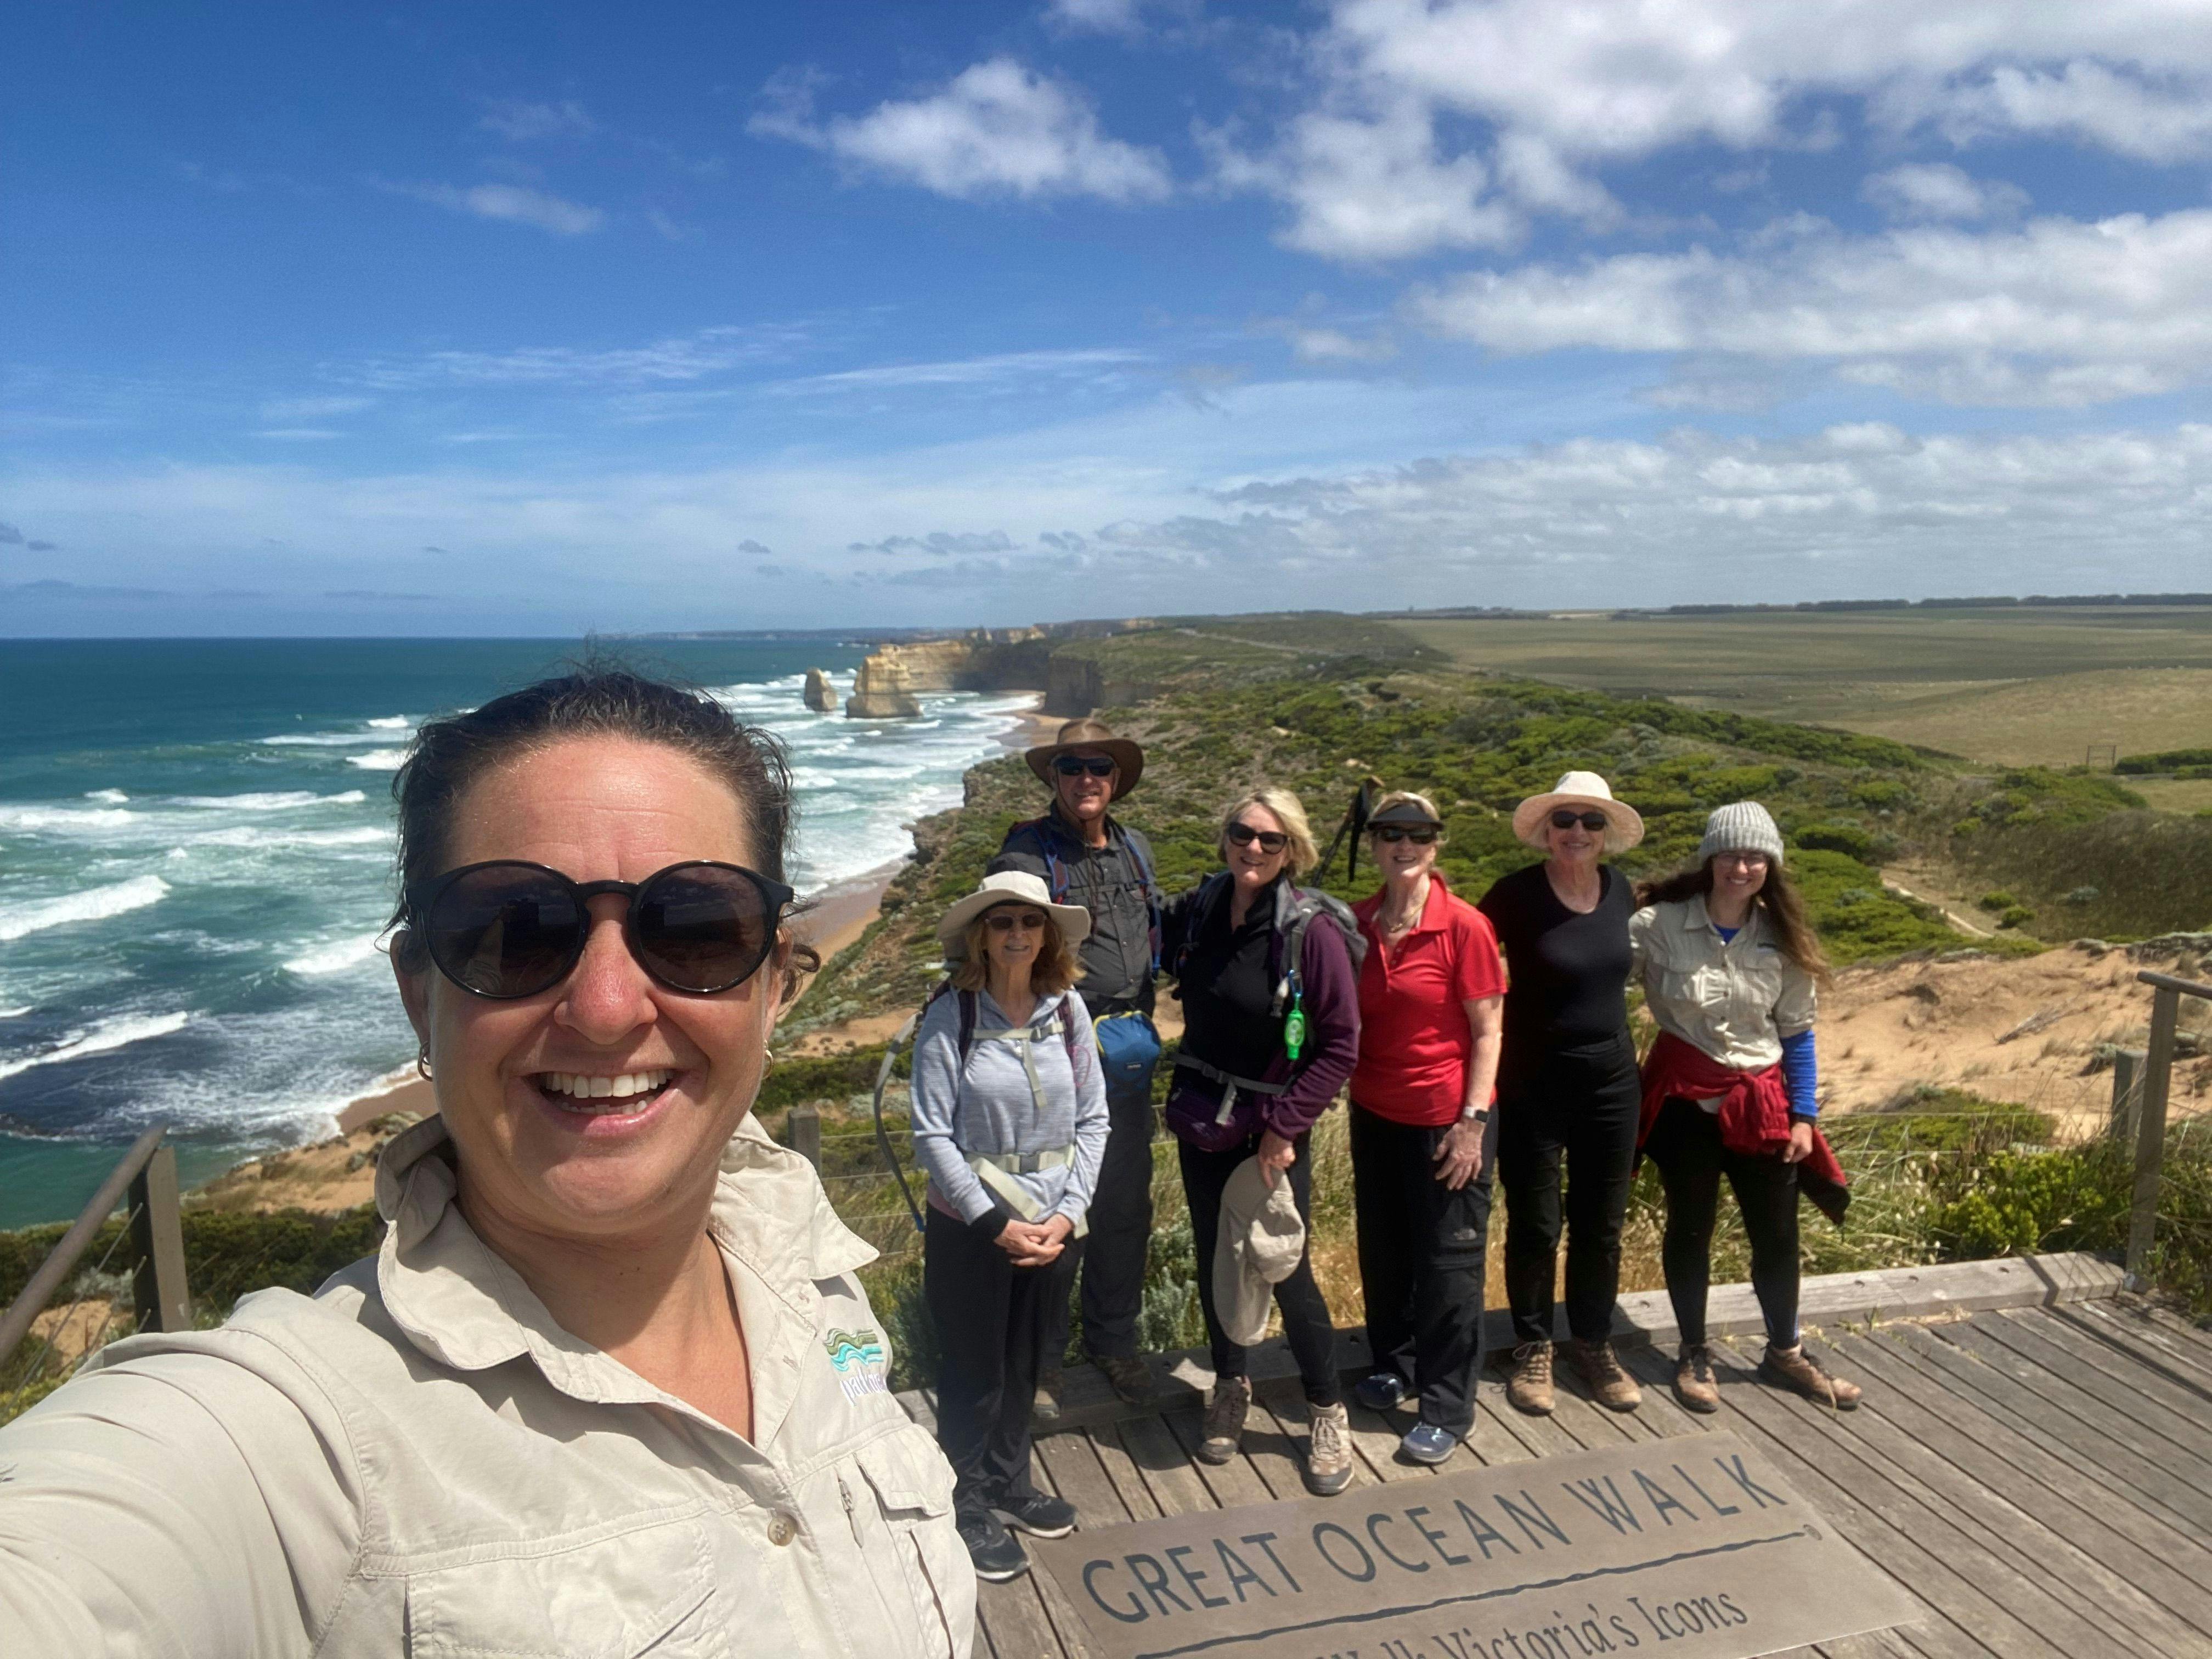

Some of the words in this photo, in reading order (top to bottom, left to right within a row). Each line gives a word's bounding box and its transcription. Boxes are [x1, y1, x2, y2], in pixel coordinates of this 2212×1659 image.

[1082, 1532, 1304, 1623] GREAT
[1312, 1490, 1572, 1582] OCEAN
[1561, 1455, 1788, 1535] WALK
[1627, 1593, 1748, 1641] Icons
